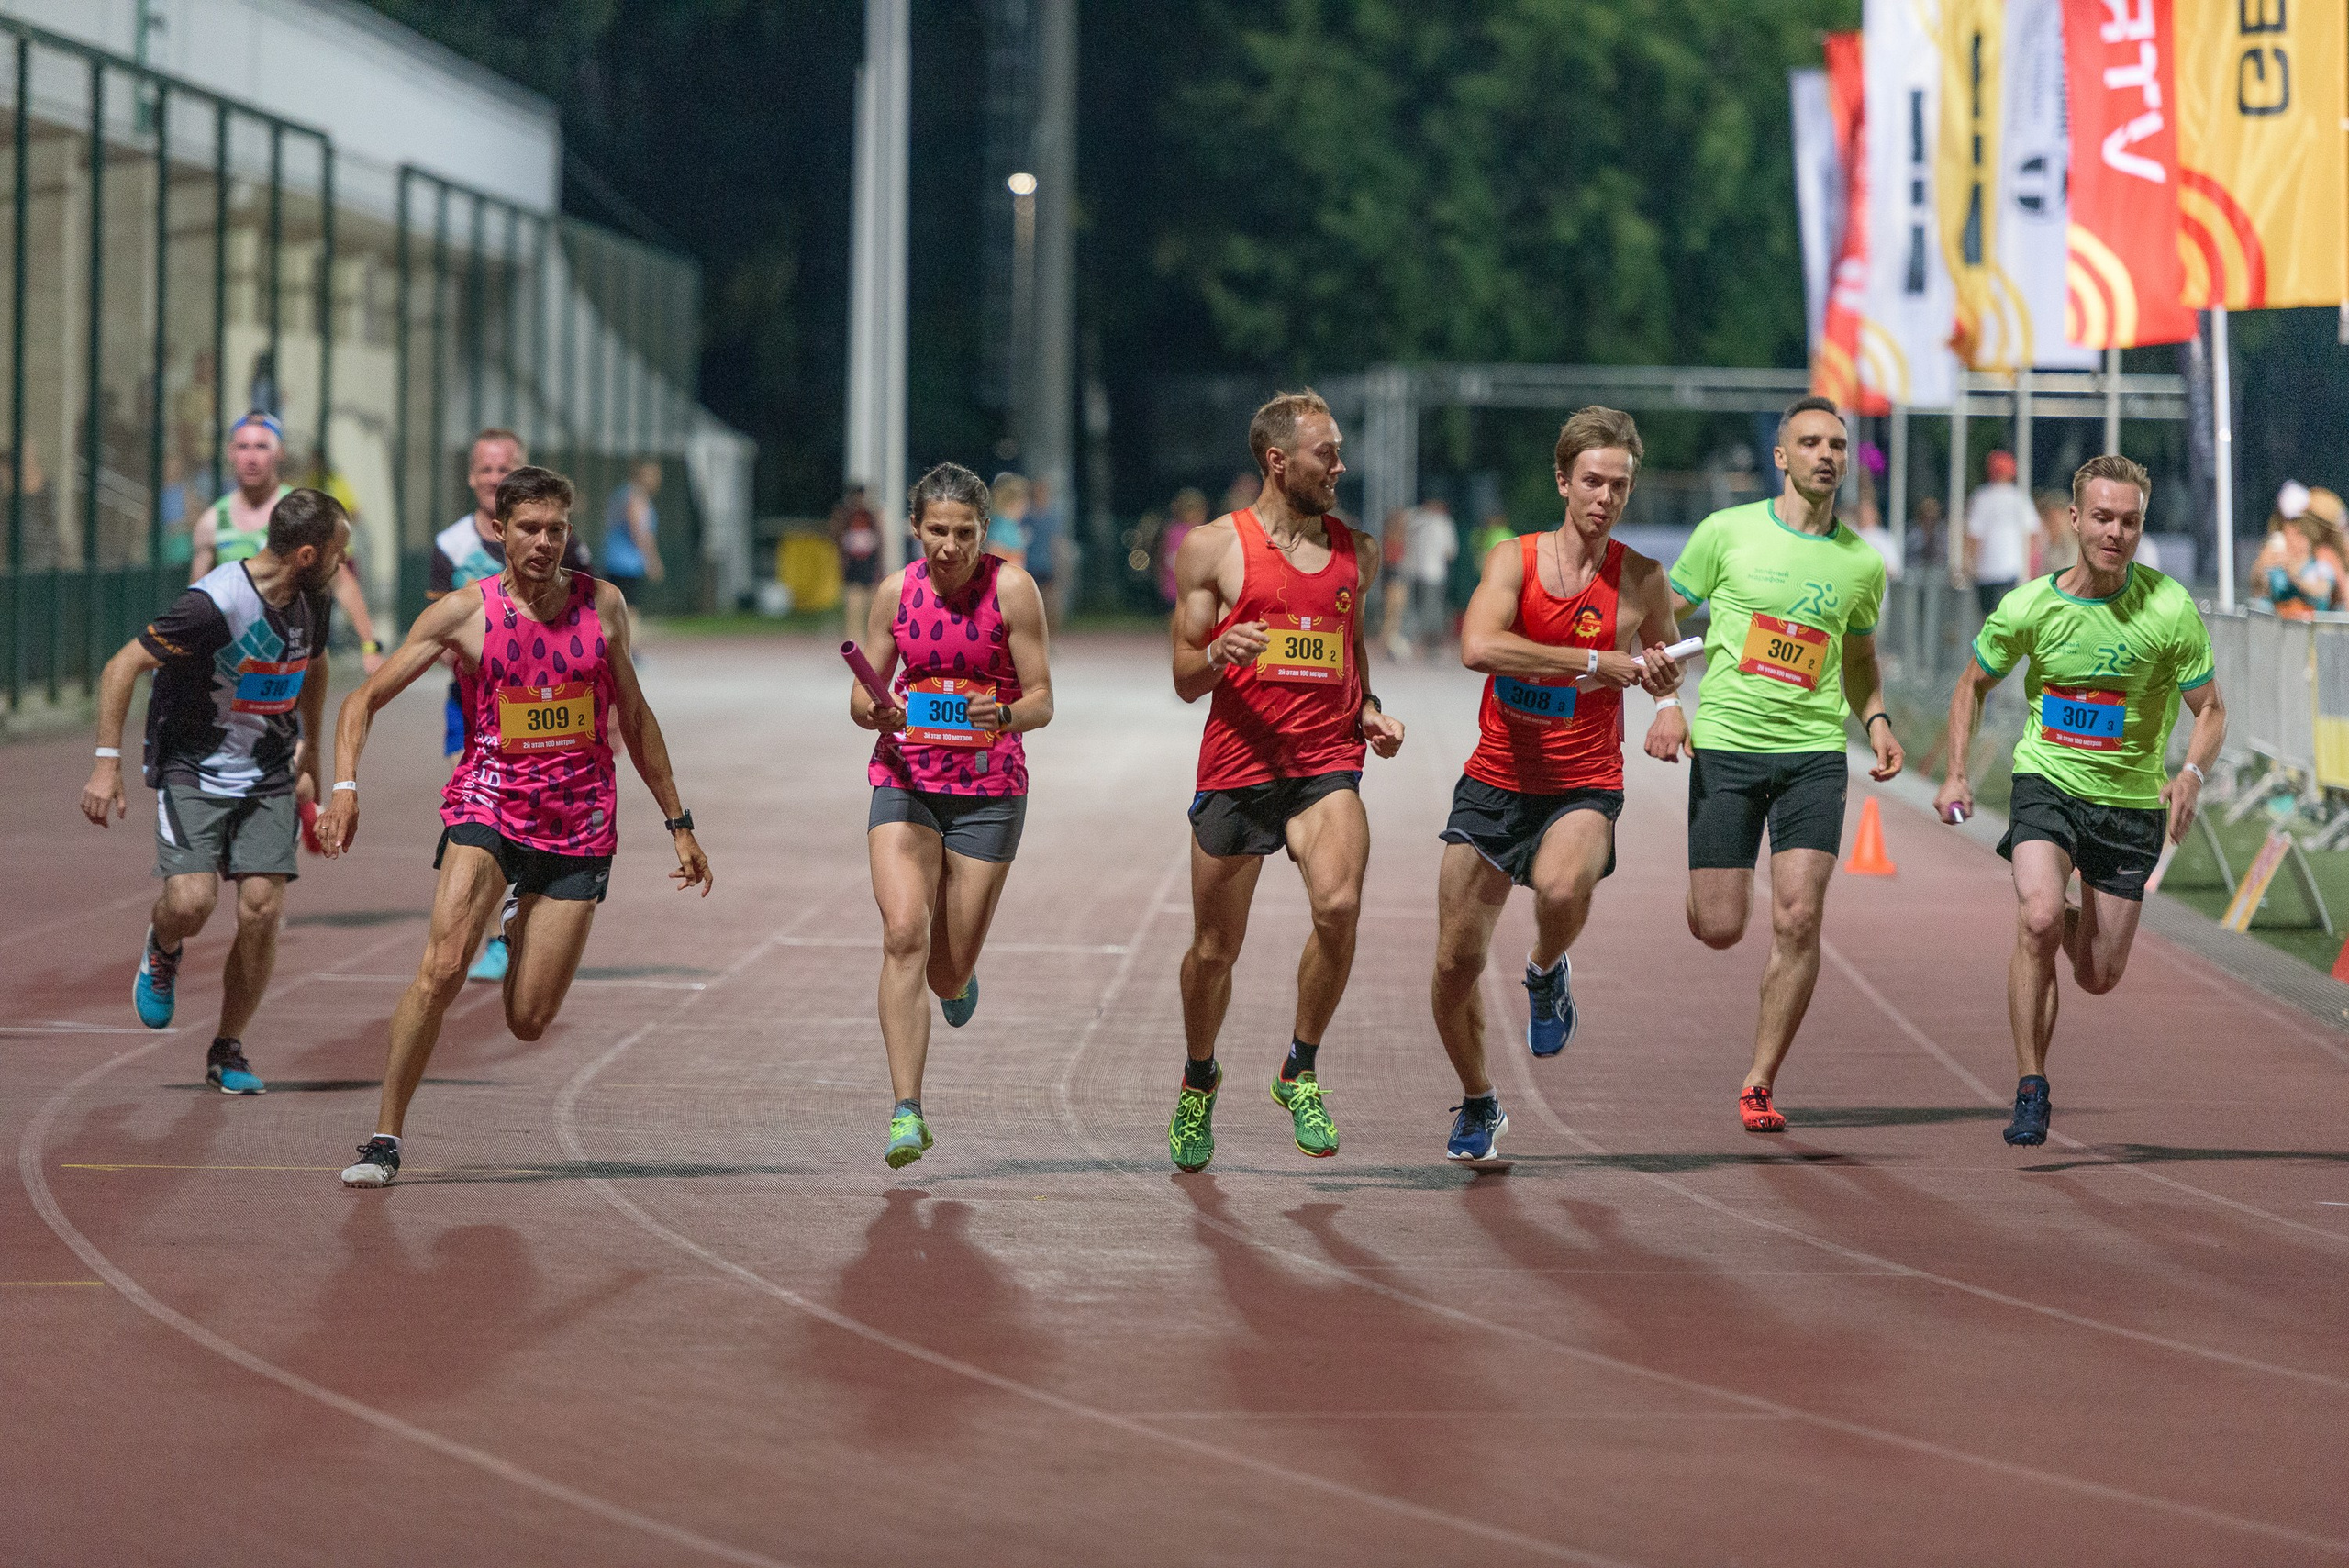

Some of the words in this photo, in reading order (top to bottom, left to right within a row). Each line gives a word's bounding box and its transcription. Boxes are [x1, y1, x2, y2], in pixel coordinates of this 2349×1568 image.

[1285, 637, 1323, 660] 308
[1330, 650, 1336, 662] 2
[1767, 639, 1804, 664] 307
[1808, 659, 1815, 670] 2
[929, 700, 967, 723] 309
[1511, 686, 1551, 710] 308
[1558, 701, 1565, 712] 3
[527, 706, 569, 731] 309
[578, 714, 584, 726] 2
[2063, 706, 2099, 729] 307
[2107, 721, 2114, 731] 3
[556, 739, 576, 747] метров
